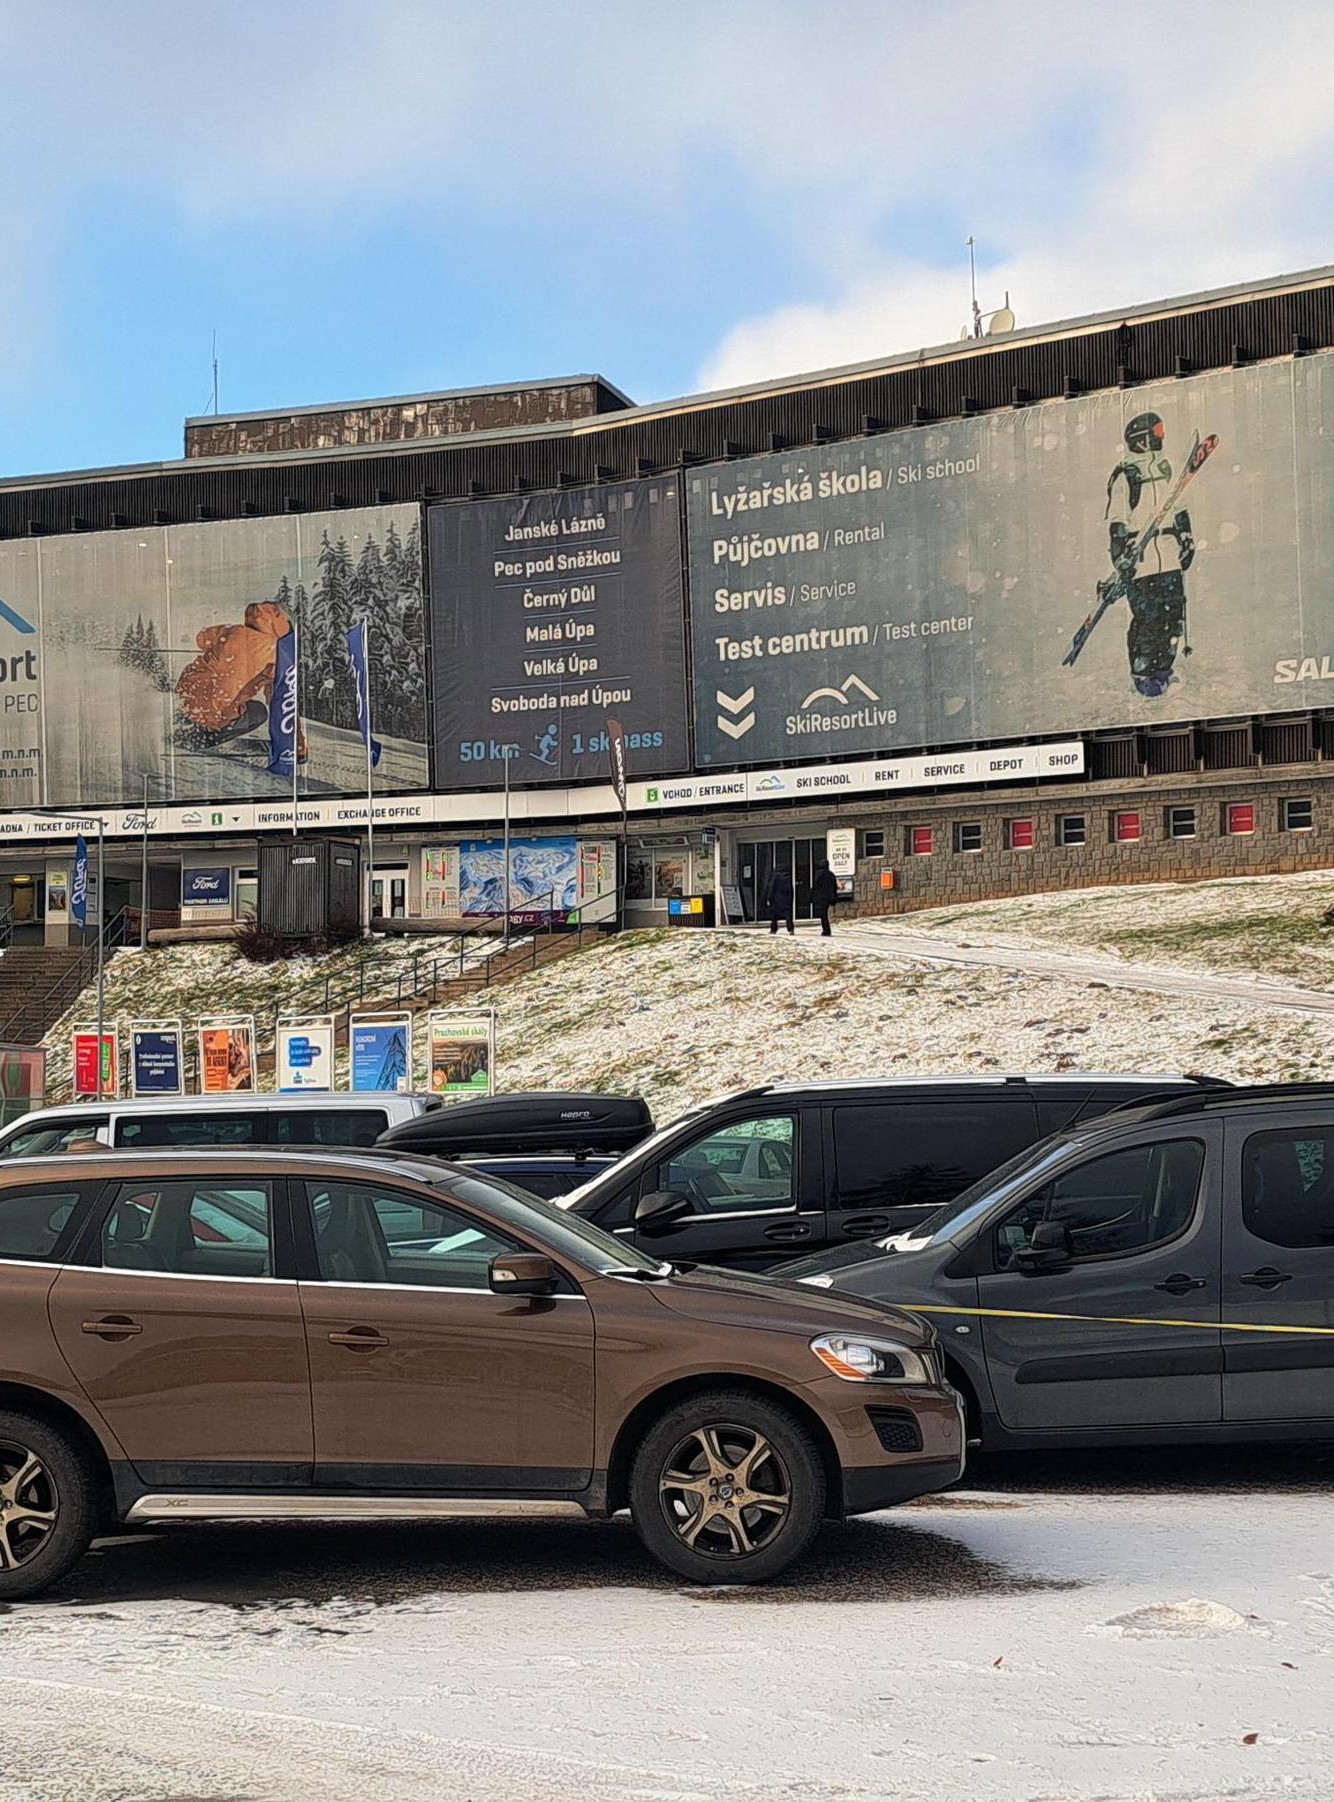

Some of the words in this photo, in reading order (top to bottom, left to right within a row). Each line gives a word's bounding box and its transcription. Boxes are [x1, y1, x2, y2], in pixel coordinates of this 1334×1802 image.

[711, 474, 813, 519] Lyžařská
[818, 465, 883, 499] škola
[897, 464, 922, 485] Ski
[925, 453, 981, 480] school
[504, 519, 559, 542] Janské
[562, 513, 606, 535] Lázně
[713, 529, 820, 565] Půjčovna
[834, 521, 885, 547] Rental
[494, 561, 524, 577] Pec
[526, 555, 554, 578] pod
[557, 549, 621, 571] Sněžkou
[523, 588, 567, 609] Černý
[570, 585, 595, 604] Důl
[714, 582, 787, 613] Servis
[800, 580, 857, 602] Service
[526, 622, 562, 643] Malá
[565, 619, 595, 641] Úpa
[715, 635, 763, 662] Test
[768, 625, 868, 656] centrum
[883, 622, 917, 641] Test
[921, 615, 975, 636] center
[524, 657, 565, 676] Velká
[568, 653, 598, 675] Úpa
[4, 693, 39, 713] PEC
[491, 693, 557, 714] Svoboda
[560, 690, 589, 708] nad
[592, 685, 631, 709] Úpou
[785, 706, 898, 735] SkiResortLive
[460, 741, 485, 762] 50
[489, 740, 520, 760] km
[571, 733, 584, 754] 1
[588, 731, 664, 753] skass
[923, 764, 965, 777] SERVICE
[989, 758, 1024, 772] DEPOT
[1048, 754, 1079, 766] SHOP
[796, 776, 812, 788] SKI
[814, 774, 851, 787] SCHOOL
[874, 769, 900, 781] RENT
[699, 783, 745, 797] ENTRANCE
[122, 813, 158, 830] Ford
[258, 810, 320, 823] INFORMATION
[388, 806, 421, 818] OFFICE
[34, 822, 63, 833] TICKET
[65, 820, 95, 832] OFFICE
[192, 876, 220, 890] Ford
